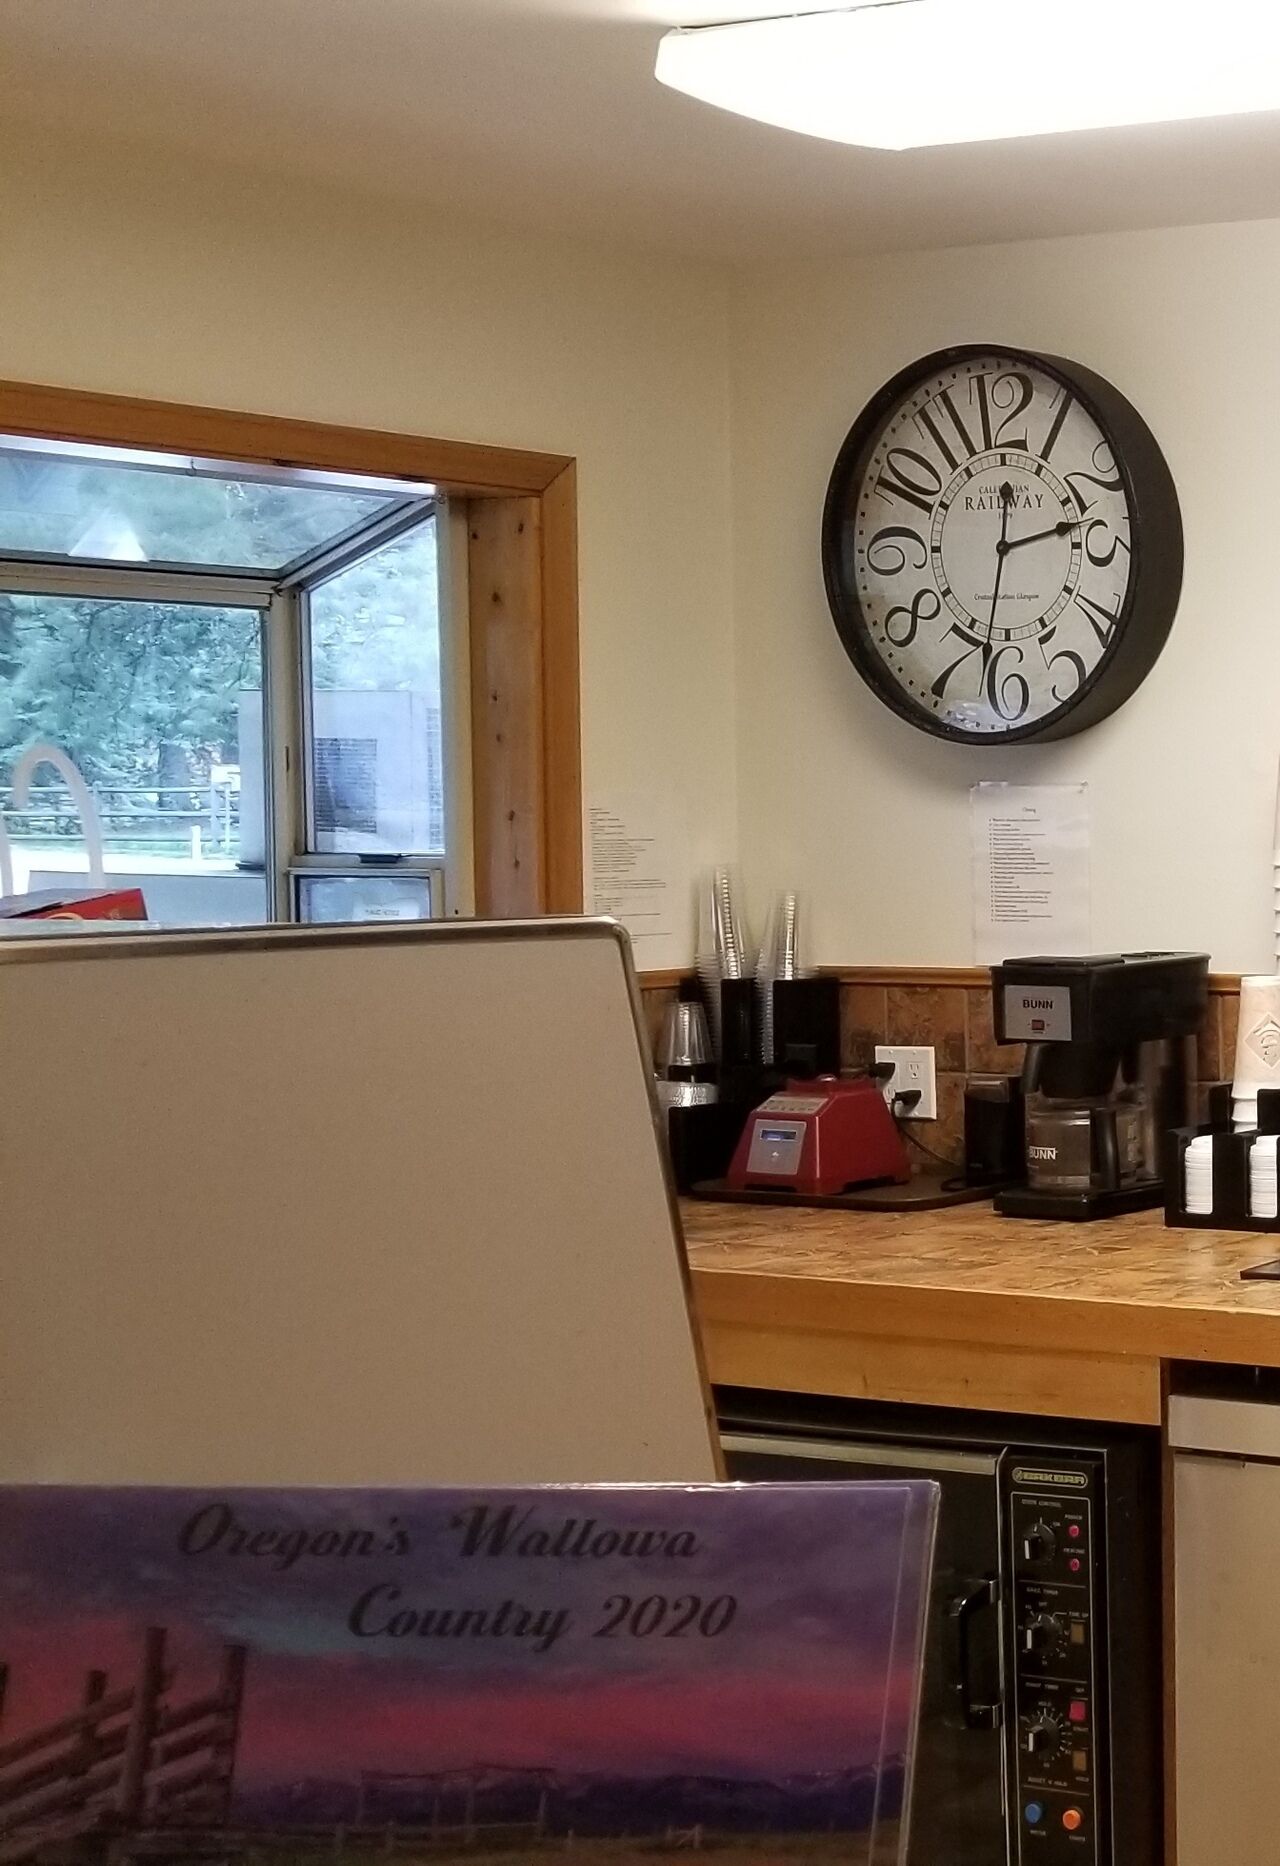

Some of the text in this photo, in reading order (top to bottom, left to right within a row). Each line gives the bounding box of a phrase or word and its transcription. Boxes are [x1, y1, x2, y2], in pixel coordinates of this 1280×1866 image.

[969, 372, 1033, 452] 12
[874, 447, 942, 519] 10
[964, 494, 1044, 511] RAILWAY
[867, 525, 928, 577] 9
[884, 587, 941, 648] 8
[931, 623, 984, 698] 7
[987, 646, 1030, 721] 6
[1022, 999, 1054, 1010] BUNN
[448, 1504, 700, 1559] Wallowa
[346, 1583, 738, 1653] Country 2020
